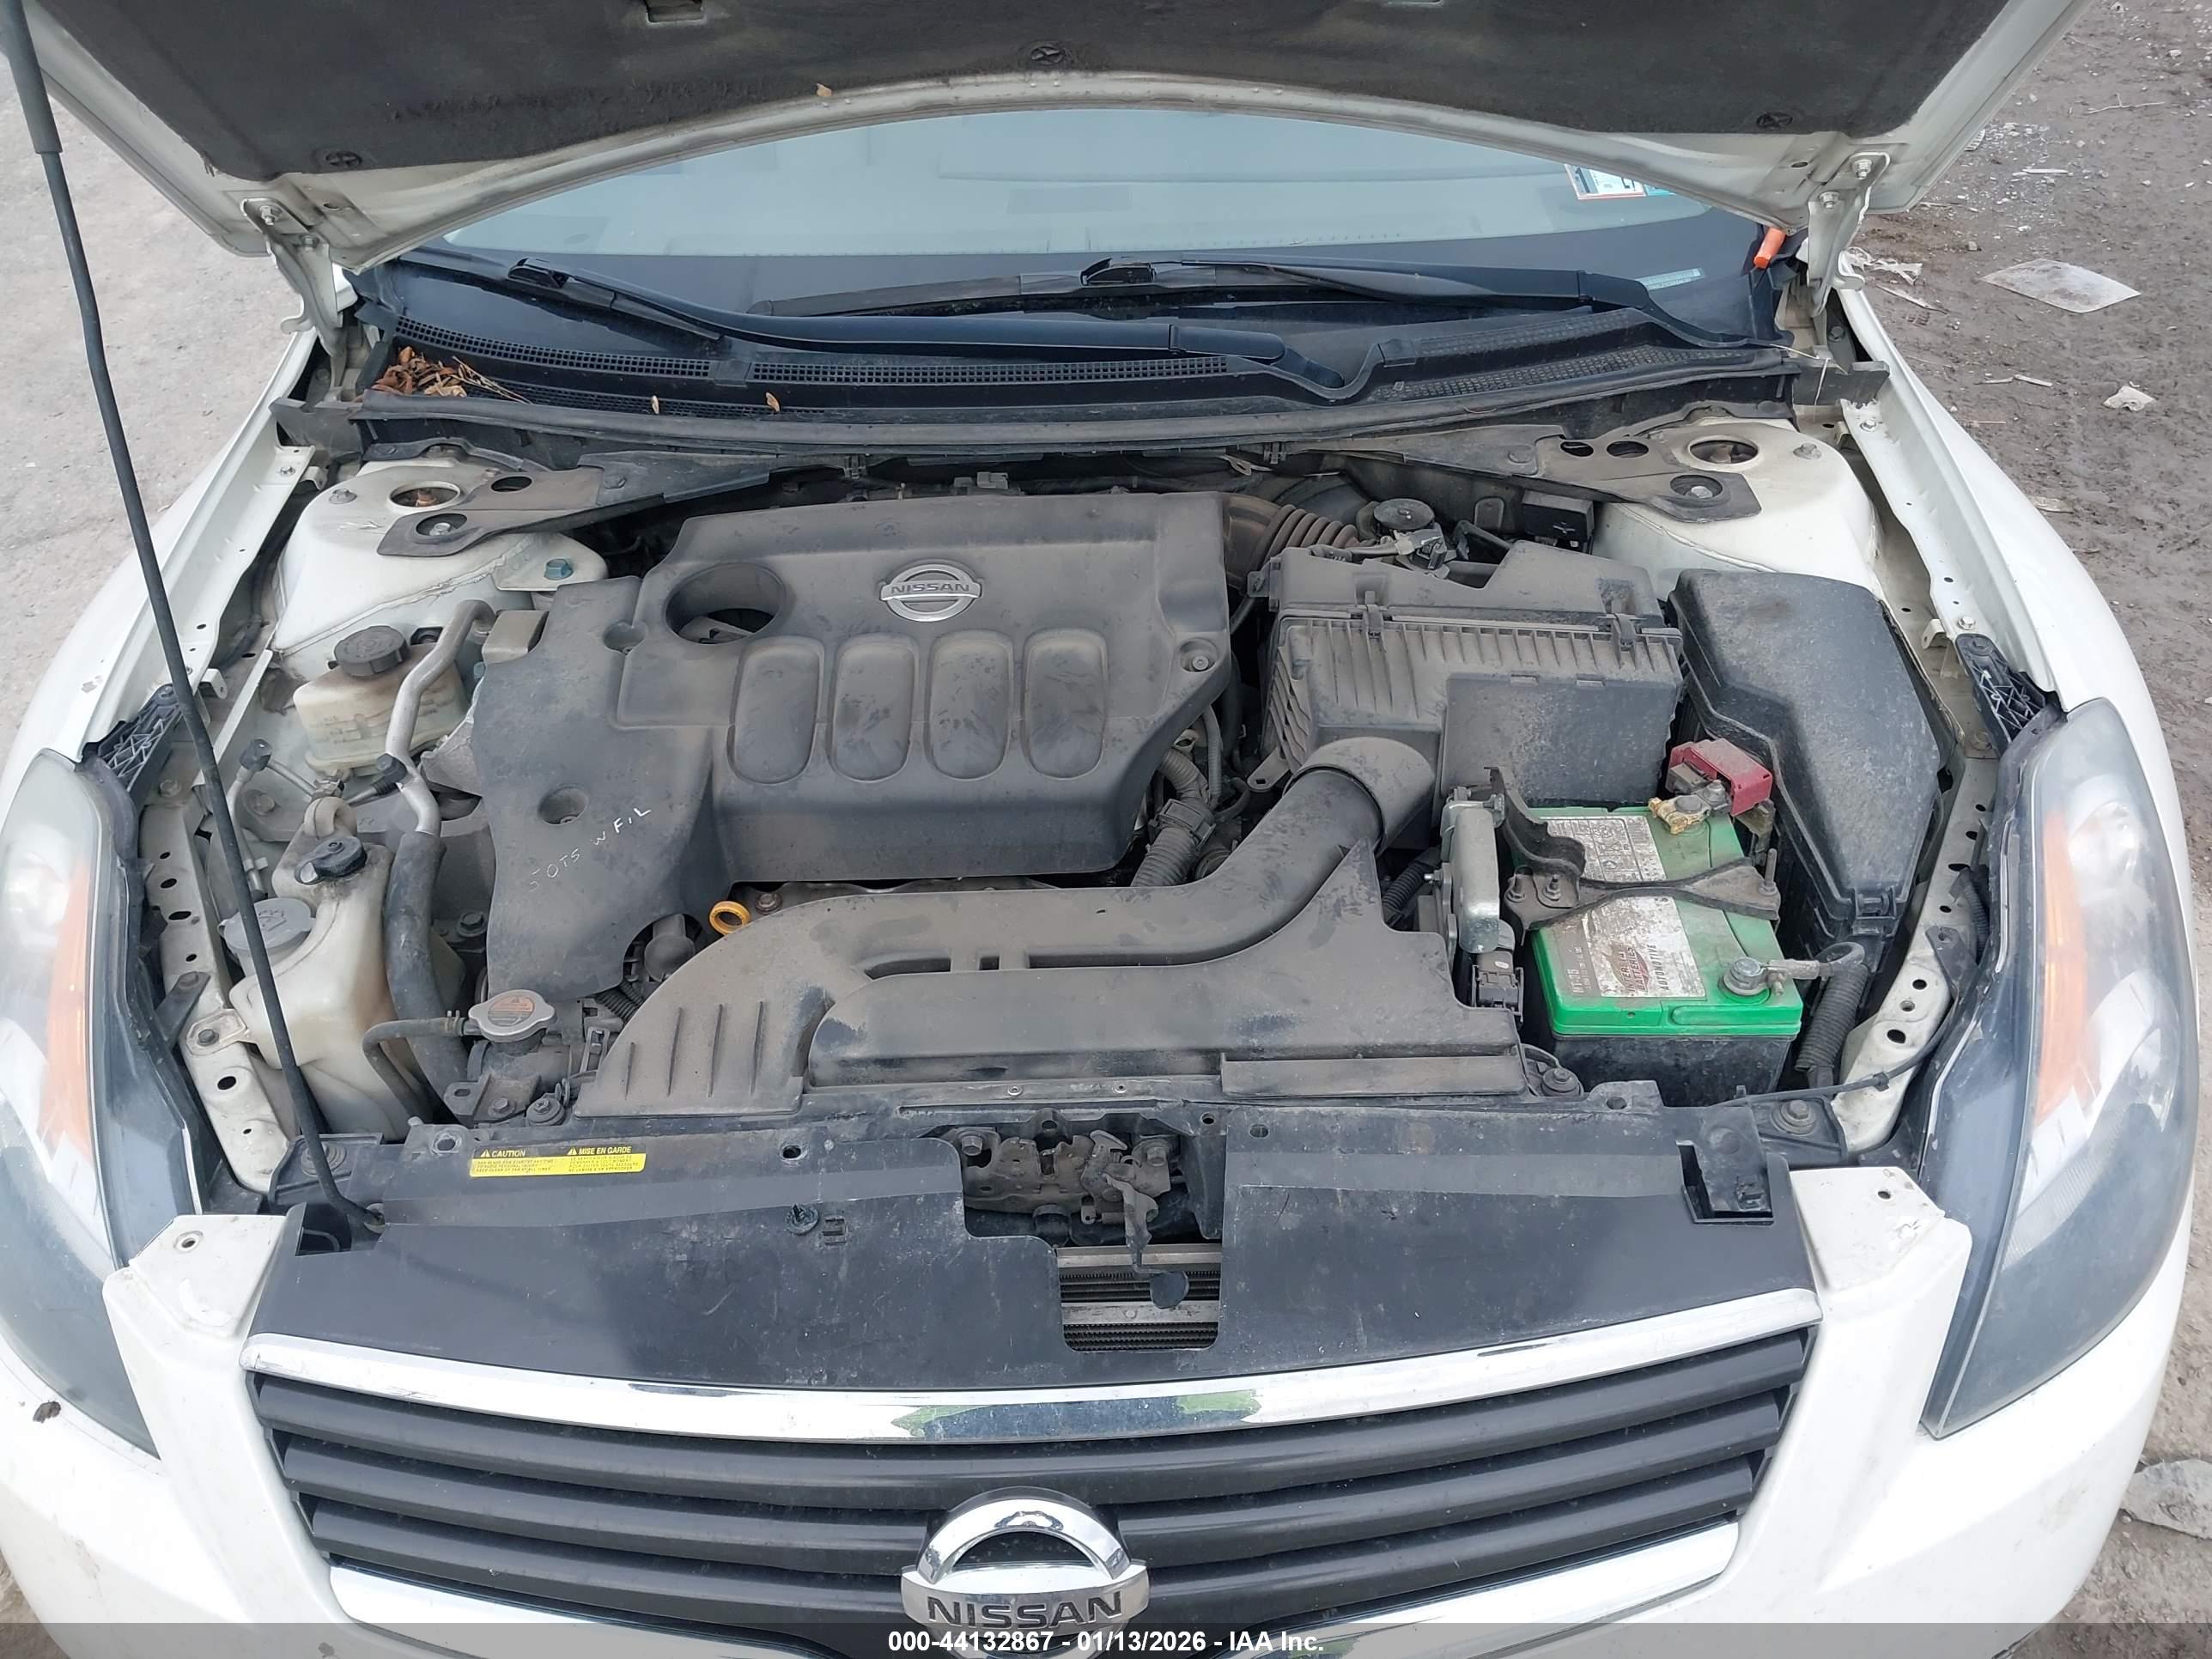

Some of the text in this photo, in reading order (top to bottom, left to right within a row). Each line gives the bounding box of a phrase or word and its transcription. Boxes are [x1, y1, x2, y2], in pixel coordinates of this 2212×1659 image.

[891, 583, 969, 594] NISSAN
[1647, 944, 1670, 991] AUTOMOTIVE
[607, 1146, 632, 1154] GARDE
[927, 1590, 1122, 1629] NISSAN
